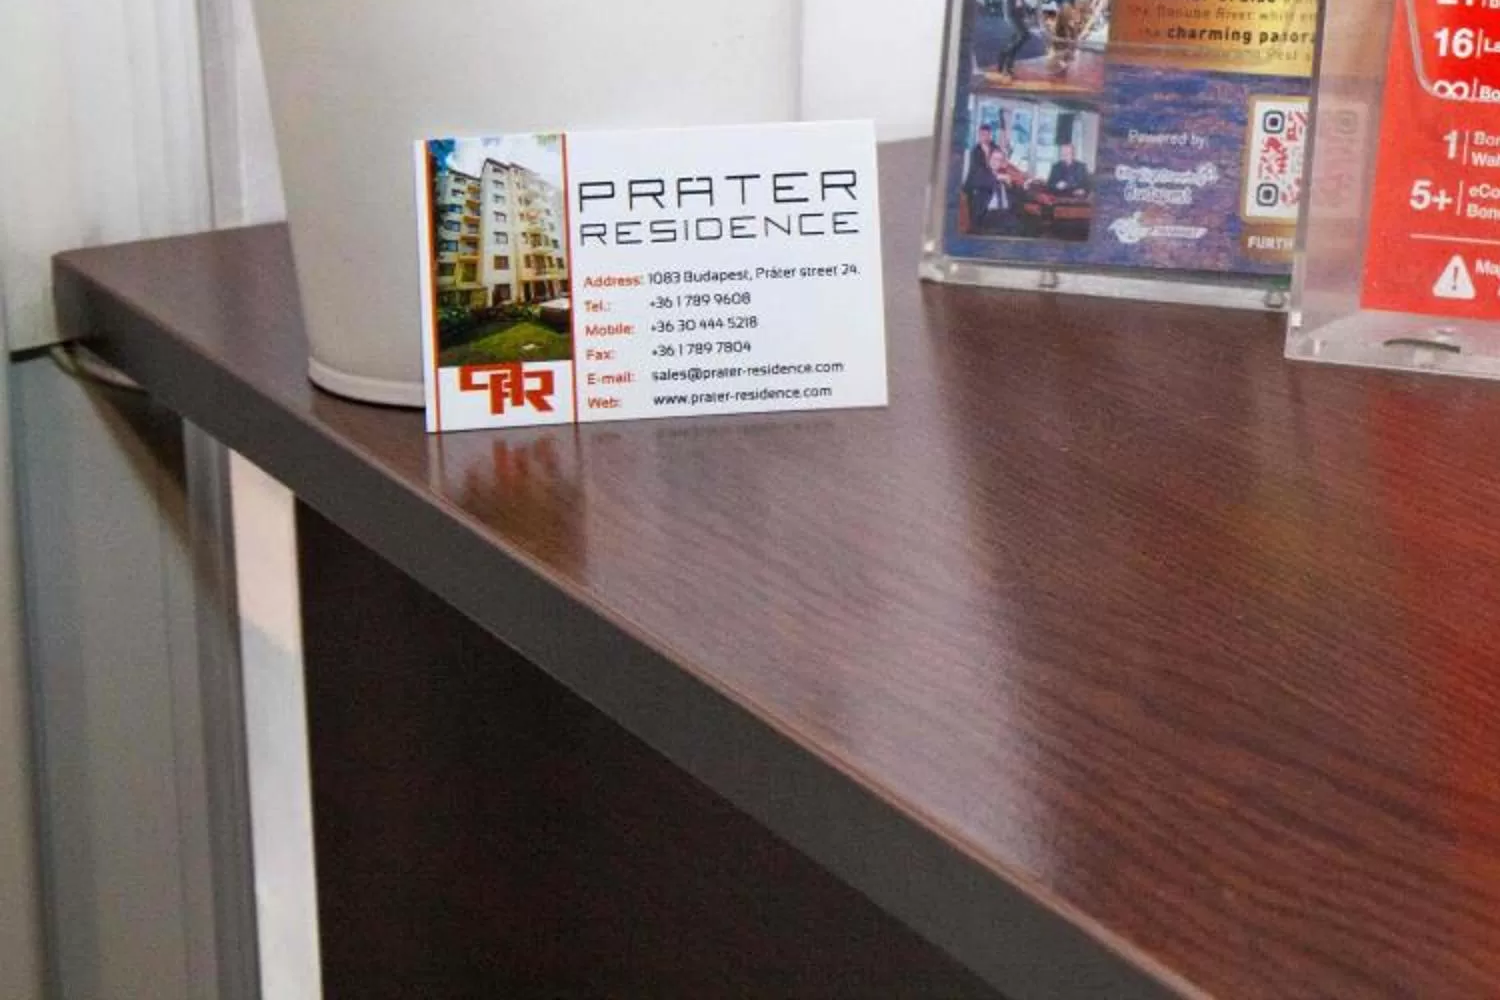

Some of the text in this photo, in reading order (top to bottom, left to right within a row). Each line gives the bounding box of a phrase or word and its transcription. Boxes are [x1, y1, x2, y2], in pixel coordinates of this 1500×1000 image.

[1167, 27, 1253, 45] charming
[1433, 27, 1474, 58] 16
[1443, 129, 1458, 159] 1
[577, 169, 859, 214] PRATER
[1409, 179, 1453, 210] 5+
[578, 210, 861, 247] RESIDENCE
[583, 273, 644, 288] Address:
[649, 270, 681, 285] 1083
[684, 267, 753, 284] Budapest,
[799, 265, 839, 278] street
[649, 295, 673, 310] +36
[684, 293, 711, 308] 789
[714, 291, 752, 306] 9608
[585, 315, 759, 338] Mobile: +36 30 444 5218
[652, 344, 676, 358] +36
[686, 342, 714, 356] 789
[716, 340, 752, 354] 7804
[587, 371, 637, 385] E-mail:
